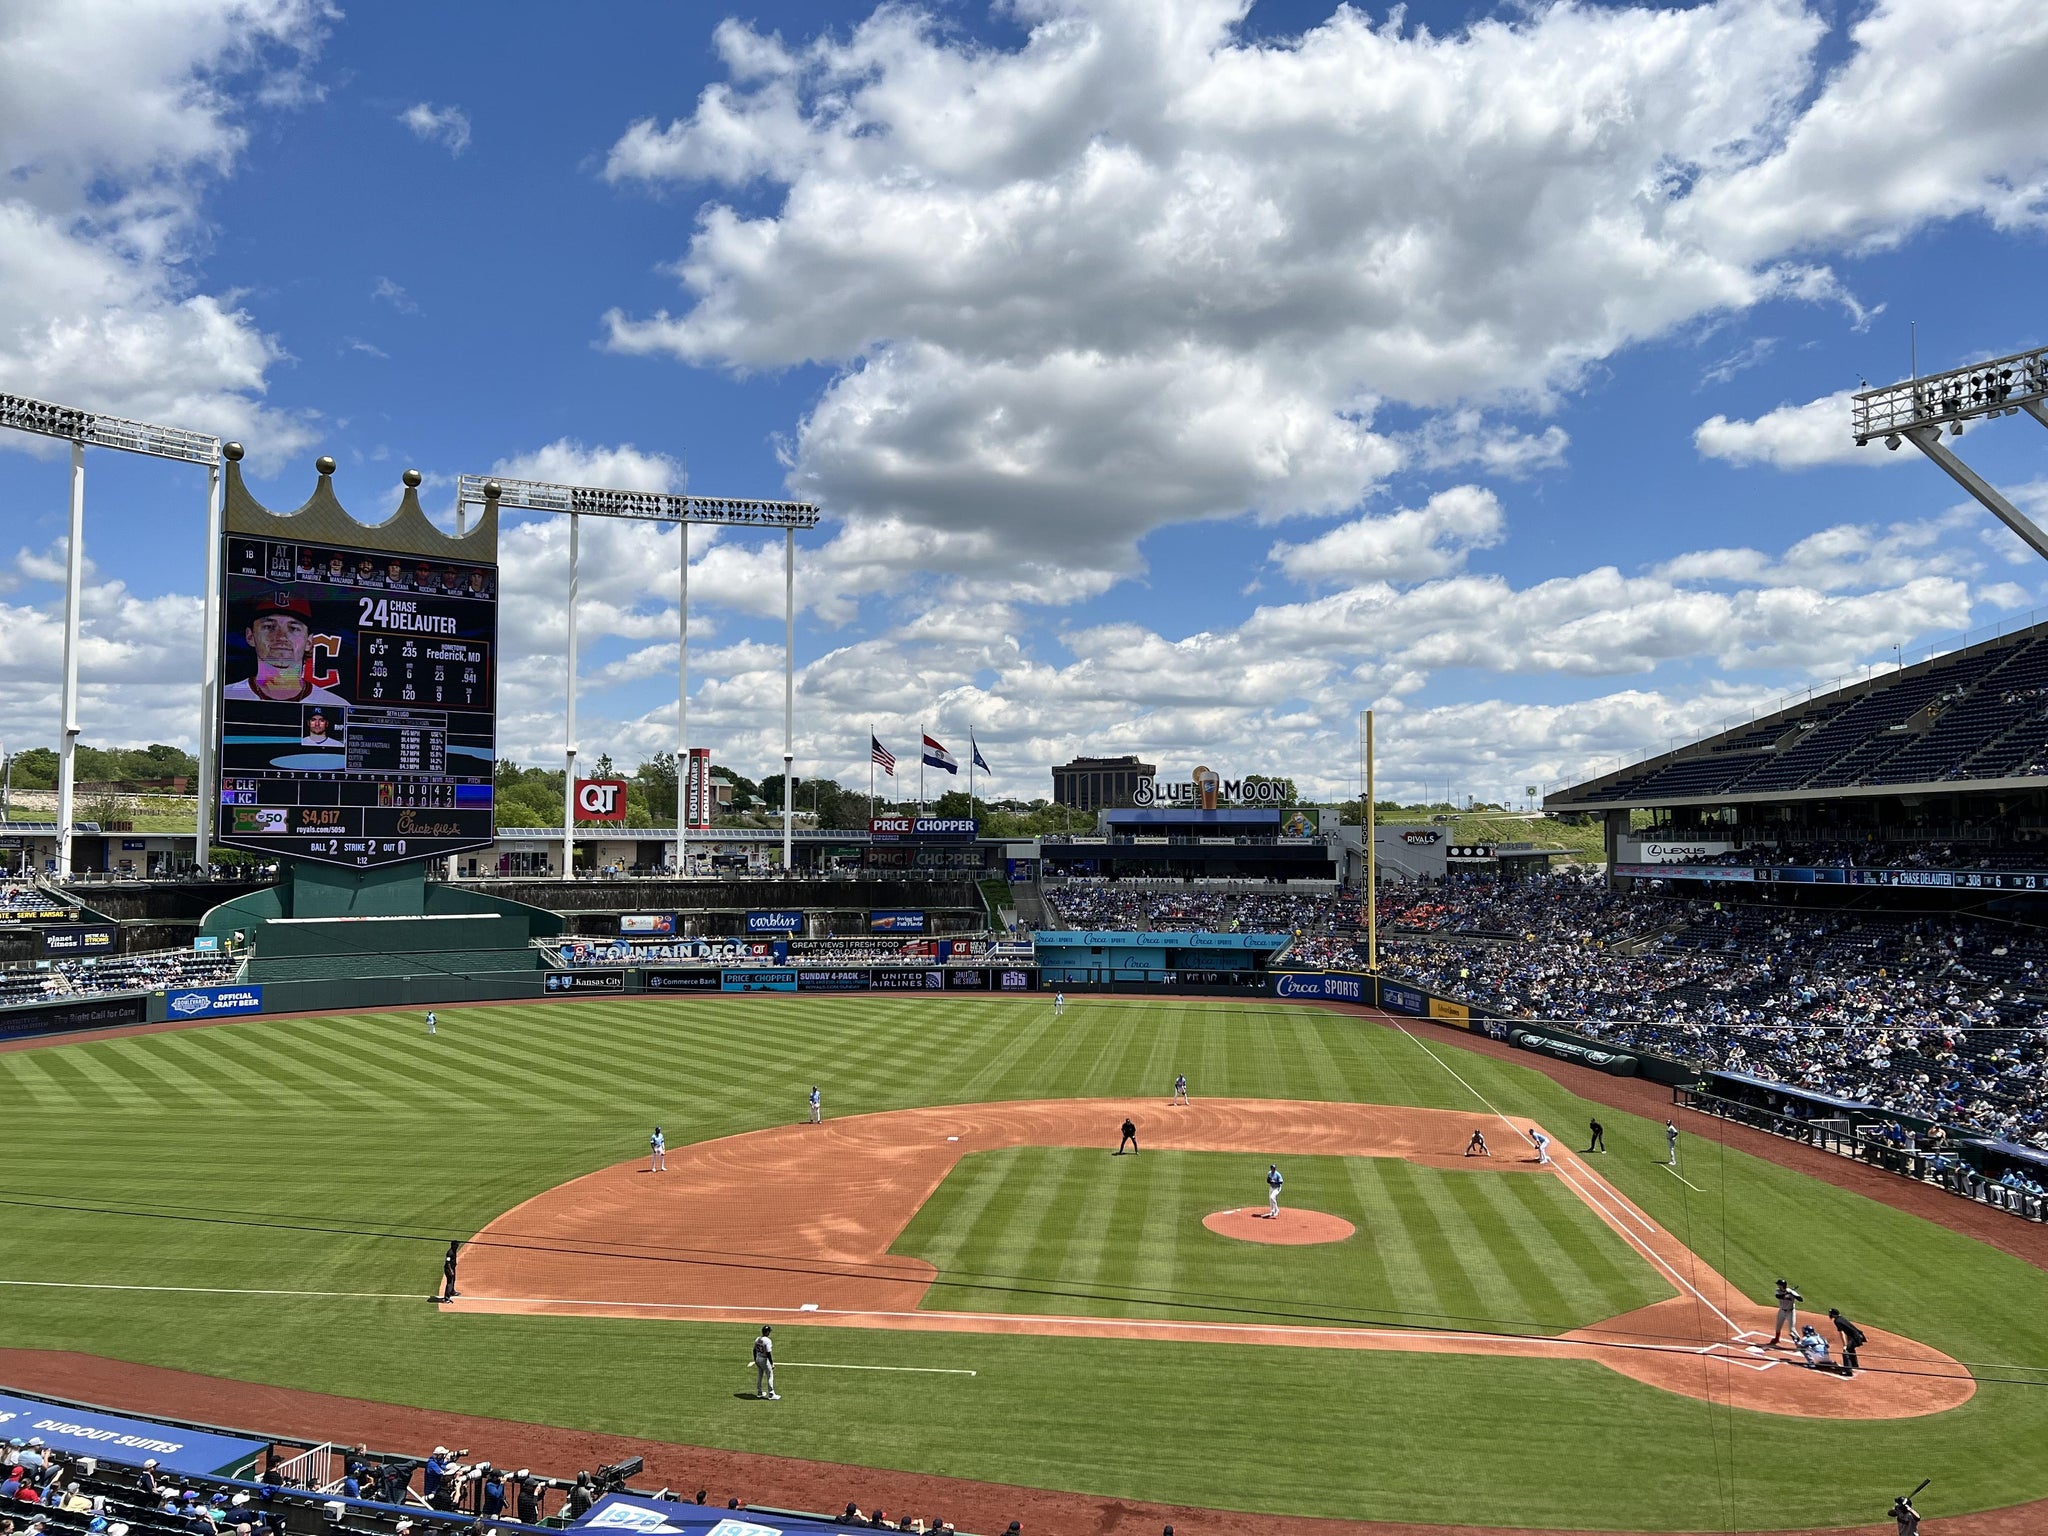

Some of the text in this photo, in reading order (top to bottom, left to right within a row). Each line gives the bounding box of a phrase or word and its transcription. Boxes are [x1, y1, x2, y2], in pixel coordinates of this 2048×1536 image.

[246, 550, 254, 558] 1B
[276, 545, 288, 557] AT
[272, 557, 291, 570] BAT
[270, 570, 291, 578] DELAUTER
[302, 573, 322, 582] RAMIREZ
[359, 597, 388, 628] 24
[390, 600, 417, 613] CHASE
[390, 612, 456, 634] DELAUTER
[402, 647, 417, 658] 235
[426, 648, 480, 662] Frederick, MD
[370, 667, 388, 677] .308
[406, 670, 412, 679] 6
[435, 672, 444, 681] 23
[462, 674, 476, 684] .941
[373, 688, 383, 698] 37
[402, 690, 415, 700] 120
[437, 692, 442, 702] 9
[467, 694, 470, 704] 1
[236, 780, 452, 796] CLE 1 0 0 4 2
[690, 762, 698, 819] BOULEVARD
[238, 793, 452, 807] KC 0 0 0 4 2
[580, 784, 618, 814] QT
[266, 814, 282, 822] 50
[302, 809, 340, 824] $4,617
[397, 810, 461, 836] Chick-fil-A
[874, 820, 974, 831] PRICE CHOPPER
[296, 826, 345, 834] royals.com/5050
[311, 840, 406, 854] BALL 2 STRIKE 2 OUT 0
[1880, 873, 1887, 883] 24
[1900, 873, 1919, 884] CHASE
[1920, 873, 1952, 885] DELAUTER
[1966, 875, 1981, 887] .308
[1996, 876, 2000, 887] 6
[2026, 876, 2035, 888] 23
[750, 912, 798, 928] carbliss
[47, 935, 72, 944] planet
[1084, 933, 1107, 945] Circa
[1137, 933, 1159, 945] Circa
[1190, 934, 1213, 946] Circa
[1244, 936, 1266, 947] Circa
[596, 944, 765, 958] FOUNTAIN DECK QT
[954, 943, 967, 952] QT
[1124, 956, 1150, 969] Circa
[576, 978, 622, 986] Kansas City
[755, 974, 792, 982] CHOPPER
[1276, 974, 1360, 997] Circa SPORTS
[176, 998, 206, 1006] BOULEVARD
[218, 993, 252, 1001] OFFICIAL
[70, 1008, 136, 1022] Right Call for Care
[32, 1418, 119, 1441] DUGOUT
[114, 1435, 184, 1454] SUITES
